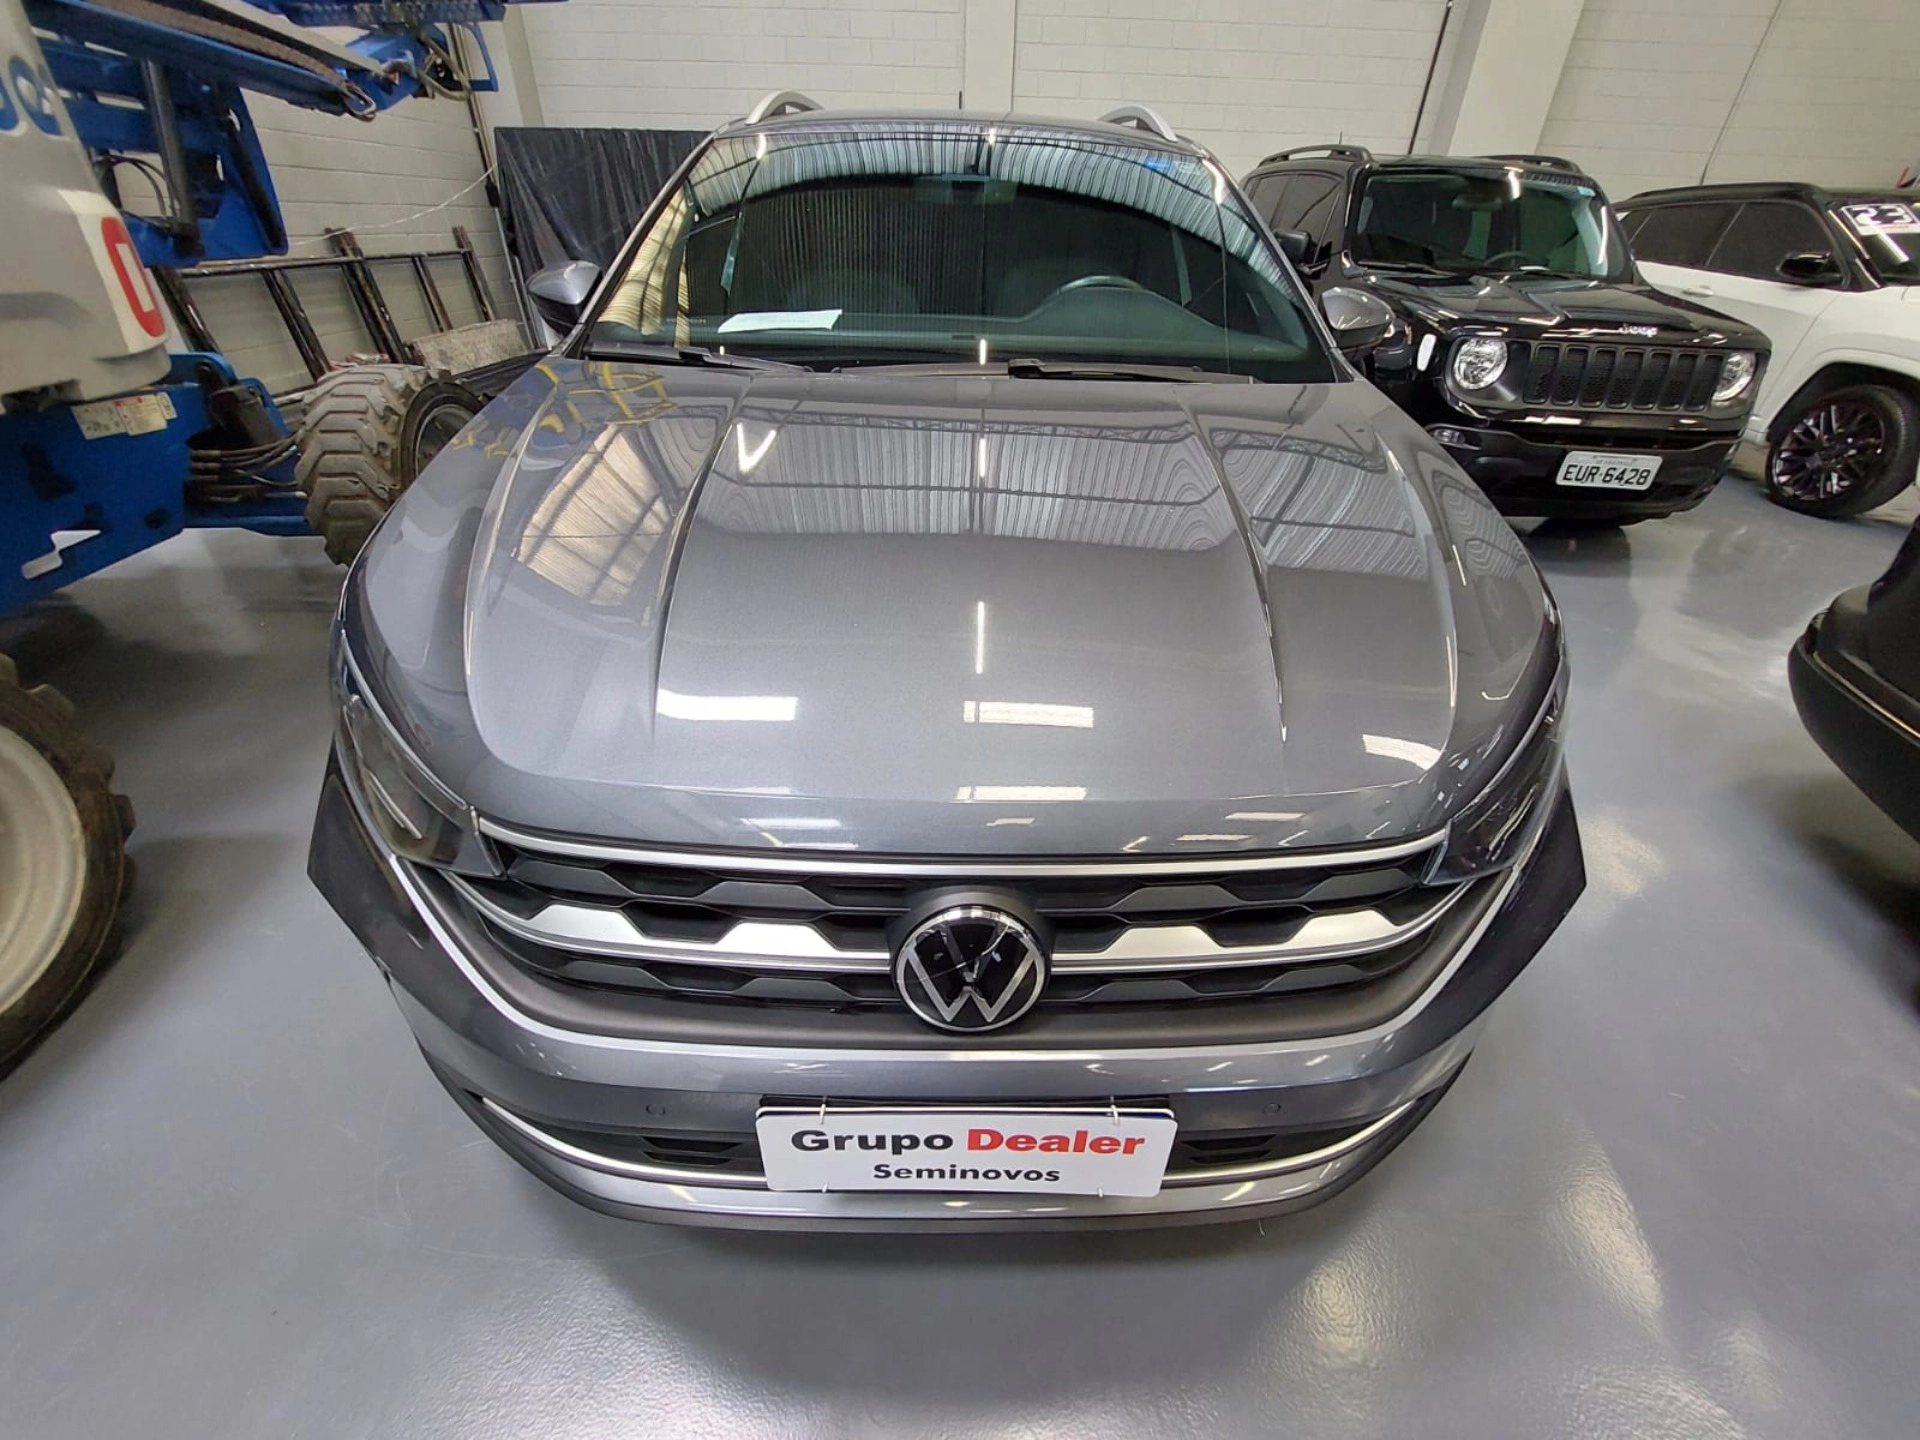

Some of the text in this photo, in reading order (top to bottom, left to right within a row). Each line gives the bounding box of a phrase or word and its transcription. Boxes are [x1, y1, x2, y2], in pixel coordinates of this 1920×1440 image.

[791, 1128, 1146, 1156] Grupo Dealer
[873, 1163, 1061, 1182] Seminovos
